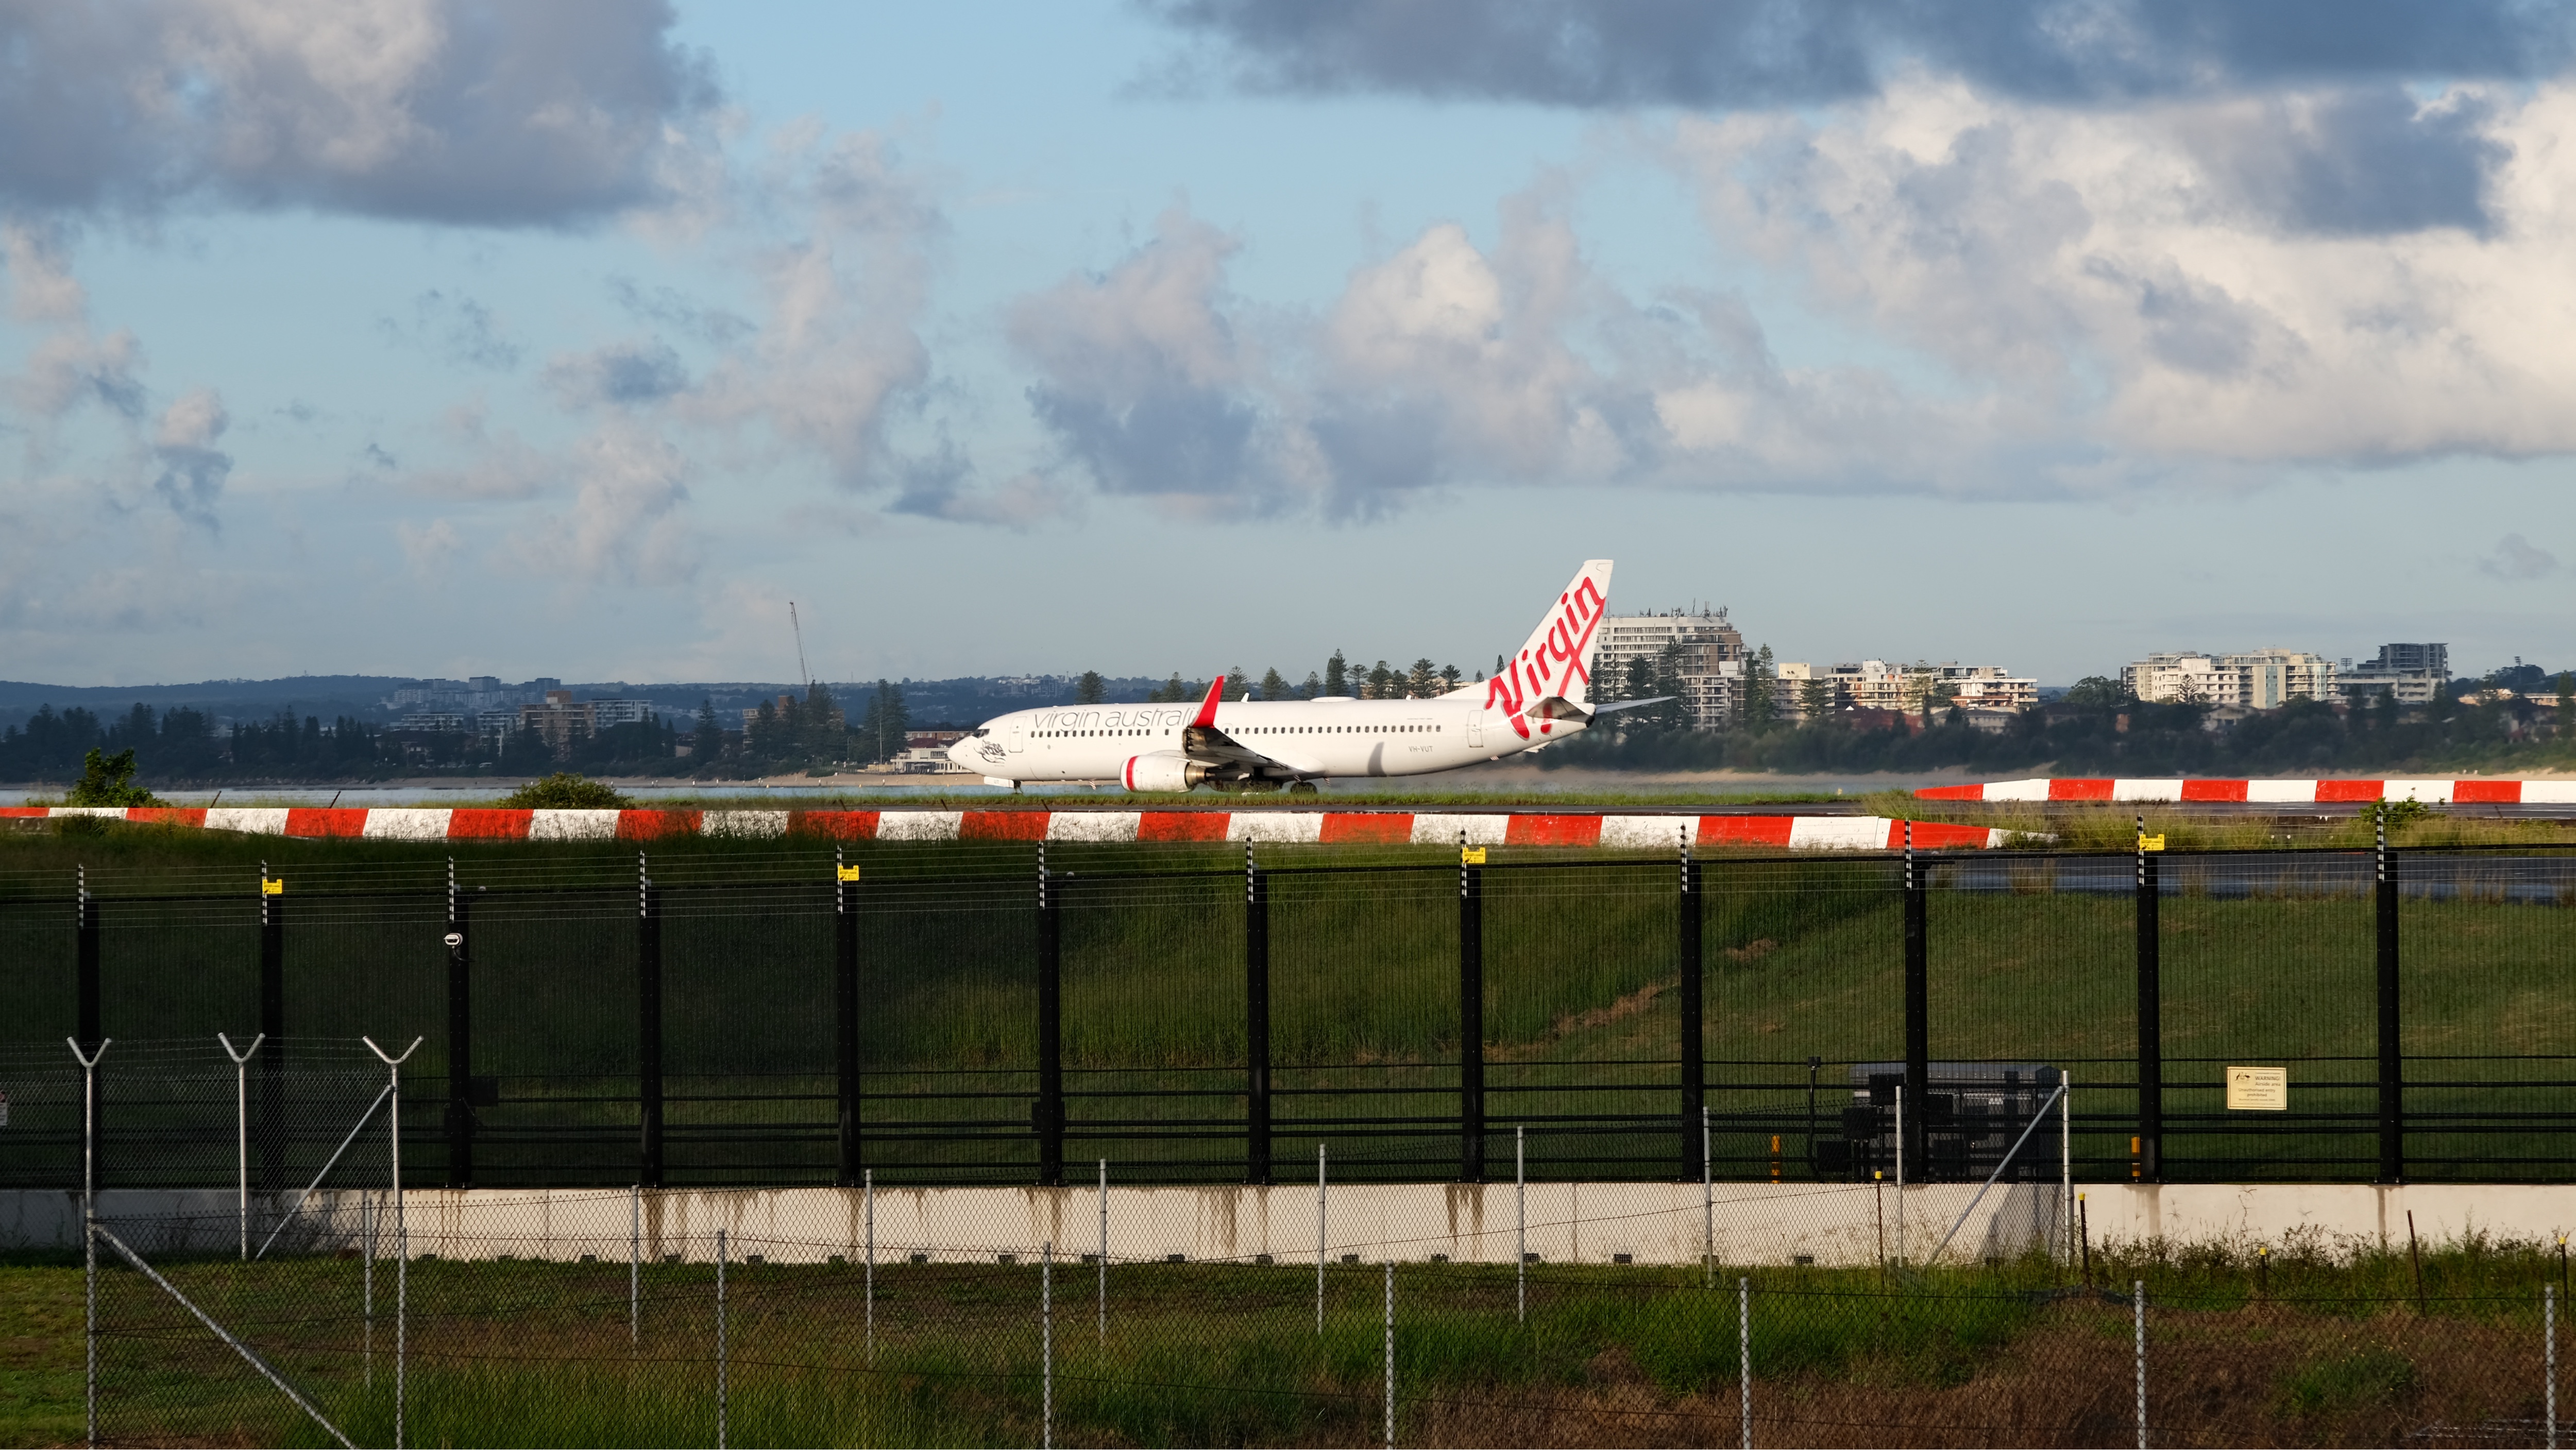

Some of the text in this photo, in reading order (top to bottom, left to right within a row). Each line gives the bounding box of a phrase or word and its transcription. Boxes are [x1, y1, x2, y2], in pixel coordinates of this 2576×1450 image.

[1484, 576, 1606, 739] Virgin
[1035, 708, 1198, 732] virgin australi
